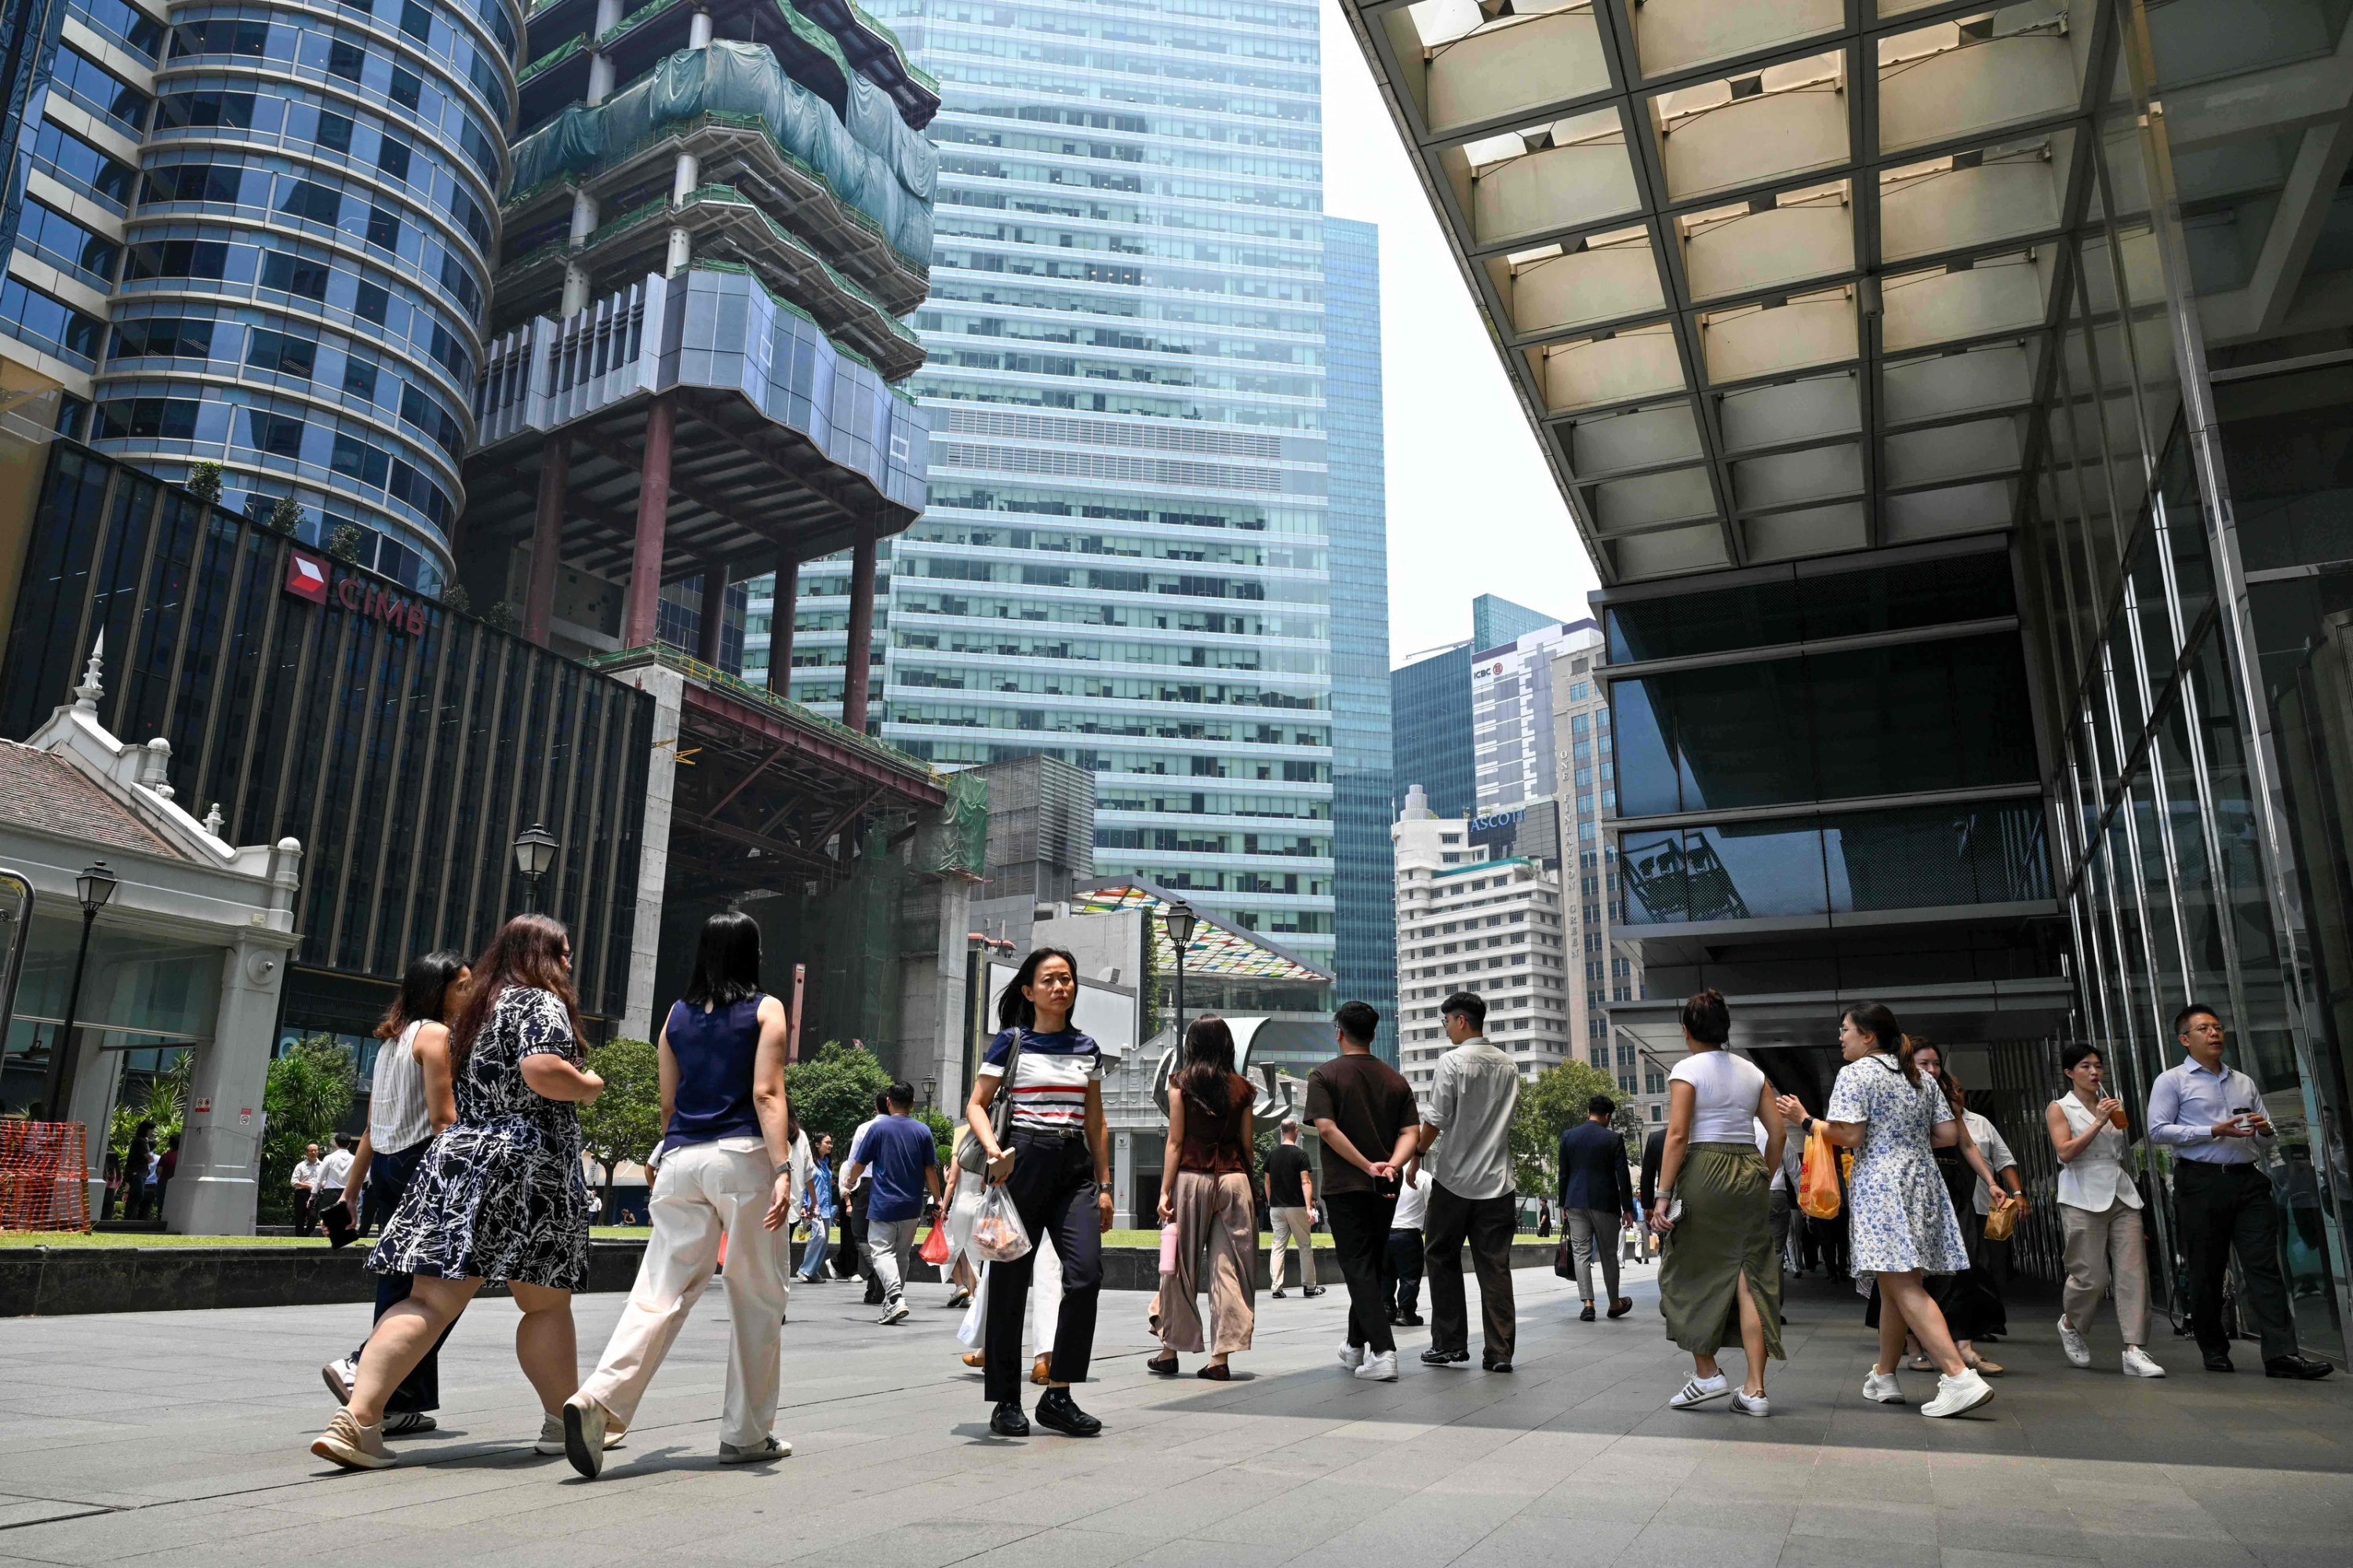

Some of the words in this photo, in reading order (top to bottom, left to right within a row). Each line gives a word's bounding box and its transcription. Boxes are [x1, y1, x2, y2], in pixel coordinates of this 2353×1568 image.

[339, 579, 425, 635] CIMB
[1474, 668, 1491, 679] ICBC
[1560, 751, 1569, 780] ONE
[1471, 809, 1526, 832] ASCOTT
[1563, 794, 1575, 890] FINLAYSON
